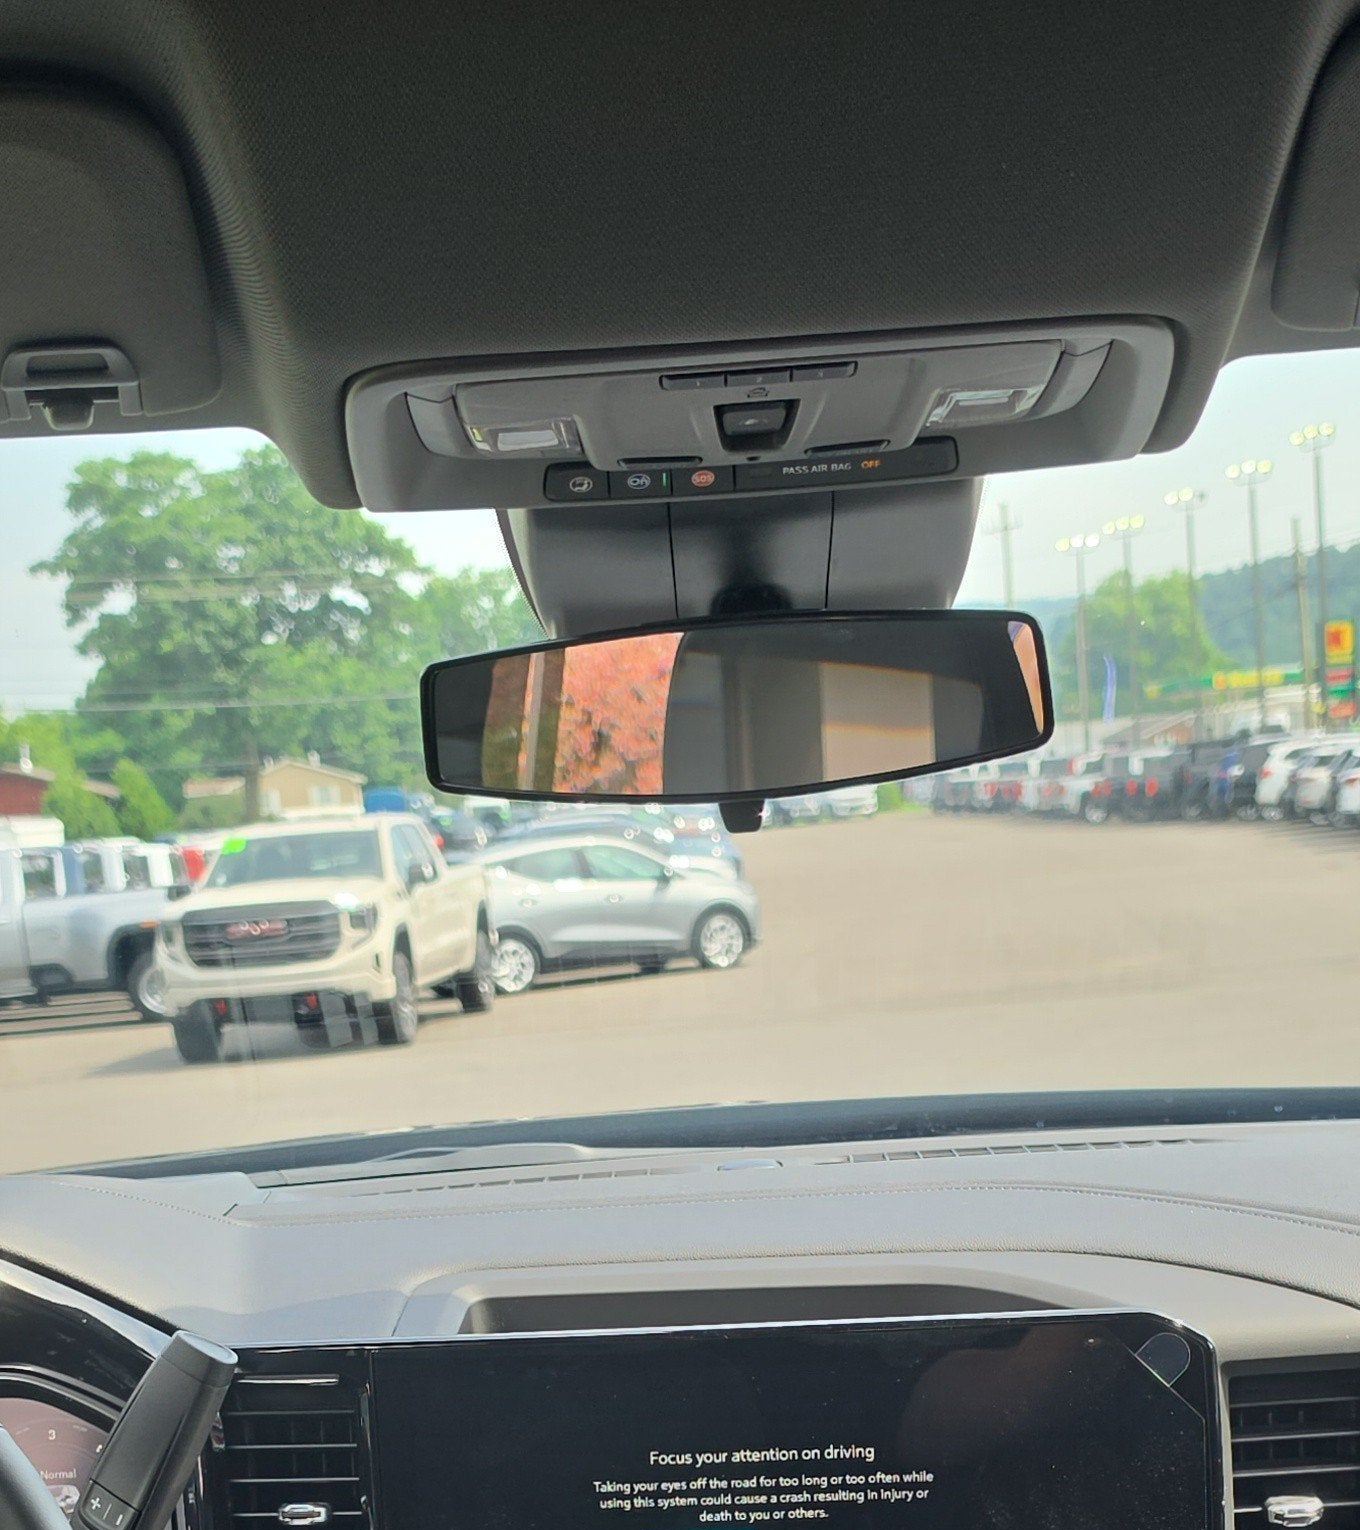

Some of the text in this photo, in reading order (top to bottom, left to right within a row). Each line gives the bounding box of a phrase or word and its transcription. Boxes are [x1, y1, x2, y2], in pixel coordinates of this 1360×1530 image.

[782, 461, 852, 475] PASS AIR BAG
[860, 459, 882, 470] OFF
[47, 1429, 56, 1440] 3
[650, 1444, 875, 1468] Focus your attention on driving
[40, 1468, 77, 1480] Normal
[593, 1470, 934, 1495] Taking your eyes off the road for too long or too often while
[600, 1488, 929, 1512] using this system could cause a crash resulting in injury or
[699, 1506, 830, 1525] death to you or others.
